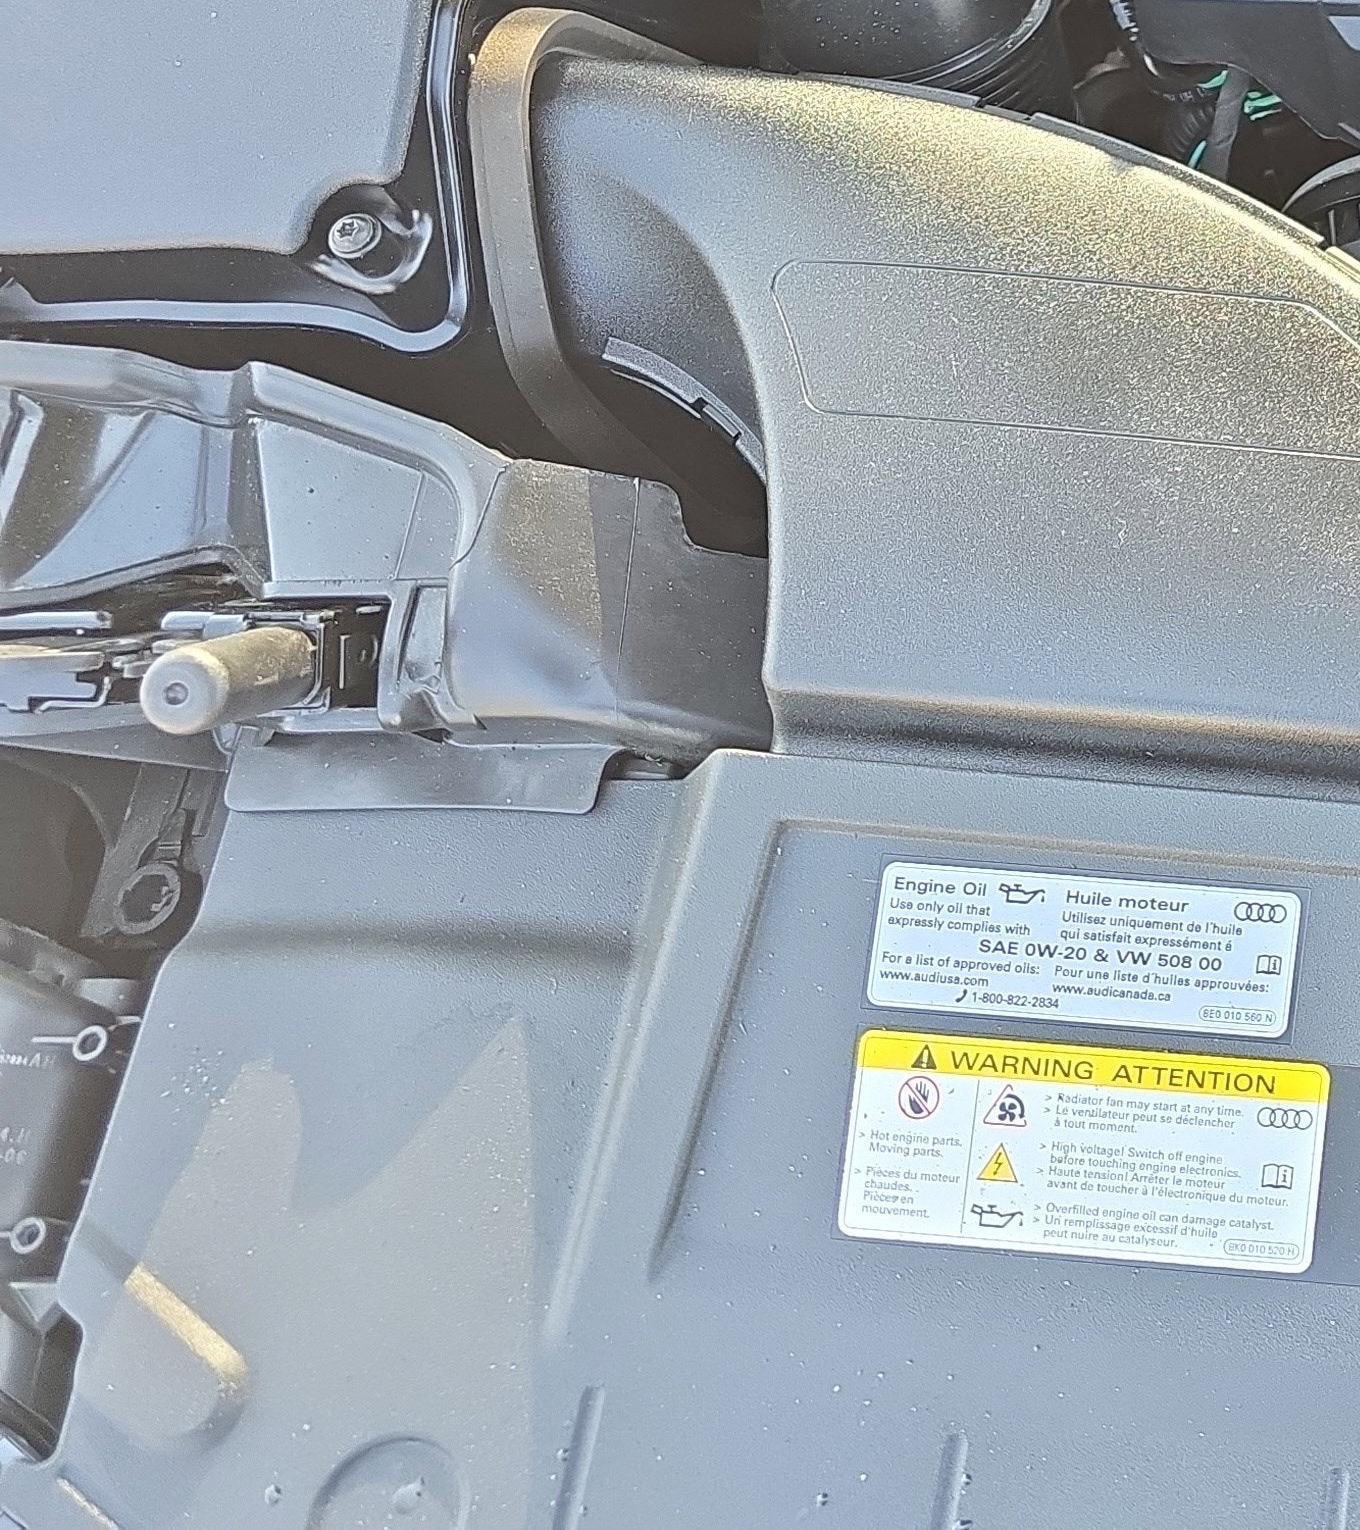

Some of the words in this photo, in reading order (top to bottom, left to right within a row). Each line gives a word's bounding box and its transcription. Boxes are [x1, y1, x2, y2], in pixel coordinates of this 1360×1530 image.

[893, 876, 956, 895] Engine
[963, 881, 987, 897] Oil
[889, 897, 914, 910] Use
[916, 900, 945, 915] only
[946, 902, 963, 914] oil
[966, 903, 991, 917] that
[1066, 889, 1112, 907] Huile
[1118, 897, 1190, 913] moteur
[887, 916, 945, 932] expressly
[946, 920, 1002, 934] complies
[1004, 923, 1031, 936] with
[1062, 910, 1107, 926] Utilisez
[1109, 915, 1184, 932] uniquement
[1186, 920, 1202, 933] de
[1060, 927, 1081, 941] qui
[1083, 929, 1132, 944] satisfait
[1134, 935, 1222, 952] expressément
[881, 950, 903, 964] For
[915, 953, 935, 967] list
[937, 956, 951, 968] of
[952, 959, 1012, 973] approved
[1014, 961, 1040, 975] oils:
[978, 939, 1019, 956] SAE
[1024, 943, 1087, 961] 0W-20
[1116, 949, 1152, 966] VW
[1157, 953, 1193, 969] 508
[1198, 956, 1222, 972] 00
[879, 970, 989, 987] www.audiusa.com
[1054, 965, 1084, 979] Pour
[1086, 970, 1110, 980] une
[1113, 969, 1139, 983] liste
[1193, 978, 1269, 993] approuvées:
[972, 991, 1059, 1009] 1-800-822-2834
[1052, 984, 1171, 1002] www.audicanada.ca
[1223, 1010, 1242, 1021] 010
[950, 1050, 1094, 1080] WARNING
[1111, 1064, 1276, 1095] ATTENTION
[1057, 1092, 1104, 1106] Radiator
[1106, 1095, 1124, 1108] fan
[1126, 1100, 1151, 1112] may
[1152, 1102, 1178, 1113] start
[1180, 1104, 1191, 1114] at
[1193, 1105, 1215, 1117] any
[1055, 1104, 1069, 1116] Le
[1071, 1107, 1130, 1121] ventilateur
[1132, 1113, 1158, 1123] peut
[1159, 1115, 1173, 1124] se
[1175, 1114, 1236, 1129] déclencher
[1063, 1118, 1086, 1130] tout
[1088, 1122, 1138, 1134] moment.
[870, 1129, 890, 1141] Hot
[892, 1131, 930, 1145] engine
[931, 1136, 963, 1147] parts.
[869, 1141, 910, 1157] Moving
[912, 1147, 944, 1158] parts.
[1051, 1140, 1077, 1155] High
[1127, 1146, 1165, 1160] Switch
[1167, 1150, 1184, 1162] off
[1185, 1152, 1223, 1165] engine
[1049, 1152, 1086, 1166] before
[1088, 1156, 1137, 1172] touching
[1138, 1161, 1177, 1174] engine
[1179, 1163, 1242, 1179] electronics.
[864, 1178, 913, 1192] chaudes.
[902, 1169, 918, 1180] du
[920, 1172, 961, 1184] moteur
[1048, 1165, 1081, 1178] Haute
[1172, 1174, 1183, 1186] le
[1184, 1178, 1226, 1190] moteur
[900, 1195, 914, 1205] en
[1046, 1179, 1078, 1191] avant
[1079, 1180, 1095, 1192] de
[1096, 1183, 1139, 1195] toucher
[1228, 1192, 1243, 1204] du
[1246, 1195, 1289, 1207] moteur.
[861, 1205, 930, 1219] mouvement.
[1045, 1201, 1100, 1217] Overfilled
[1102, 1208, 1140, 1221] engine
[1141, 1210, 1157, 1221] oil
[1158, 1213, 1179, 1223] can
[1181, 1213, 1226, 1229] damage
[1228, 1218, 1275, 1232] catalyst.
[1044, 1214, 1062, 1226] Un
[1063, 1218, 1131, 1233] remplissage
[1133, 1222, 1179, 1235] excessif
[1042, 1229, 1068, 1239] peut
[1070, 1229, 1100, 1241] nuire
[1101, 1233, 1116, 1243] au
[1117, 1235, 1178, 1248] catalyseur.
[1248, 1243, 1266, 1255] 010
[1267, 1245, 1286, 1256] 520
